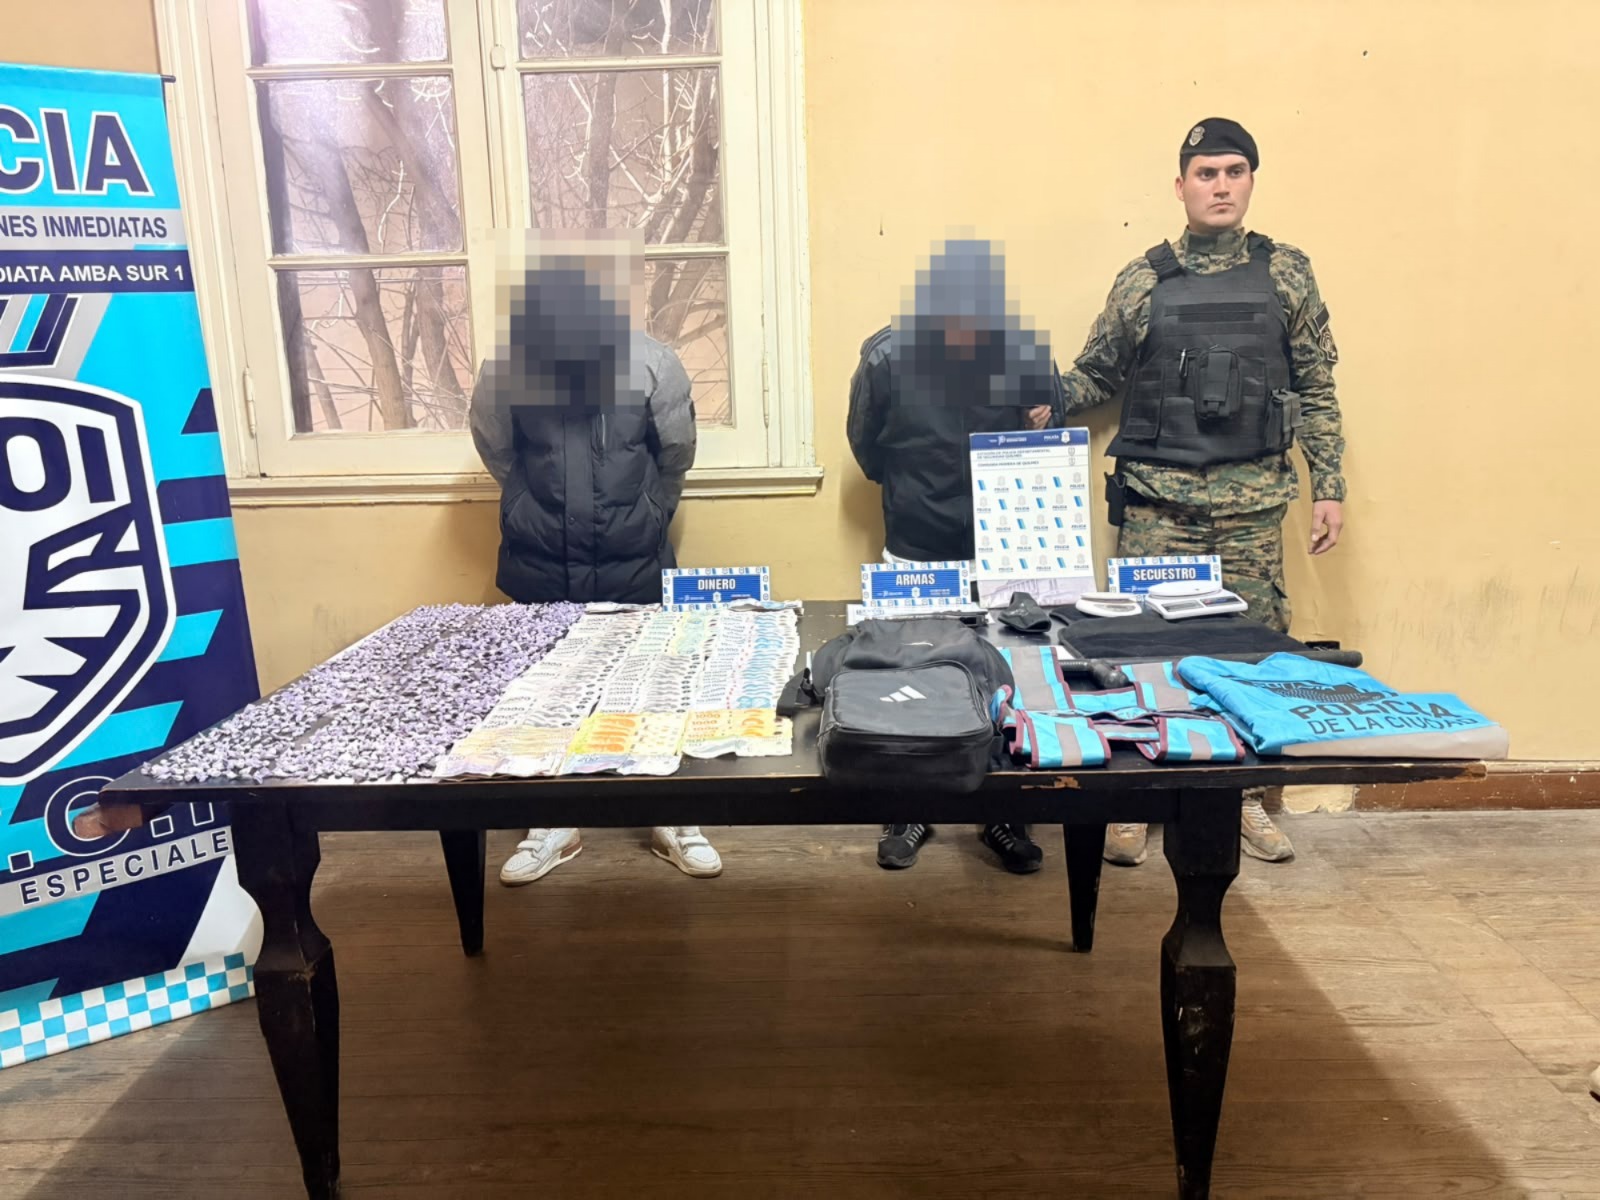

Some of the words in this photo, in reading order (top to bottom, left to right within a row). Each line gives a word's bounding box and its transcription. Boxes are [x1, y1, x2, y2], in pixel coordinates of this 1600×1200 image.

[43, 215, 167, 238] INMEDIATAS
[60, 265, 122, 282] AMBA
[127, 265, 169, 281] SUR
[174, 265, 184, 281] 1
[896, 573, 935, 586] ARMAS
[1133, 568, 1196, 581] SECUESTRO
[698, 578, 736, 590] DINERO
[1308, 718, 1344, 735] DE
[1346, 716, 1384, 731] LA
[1384, 716, 1479, 730] CIUDAD
[20, 829, 230, 906] ESPECIALE
